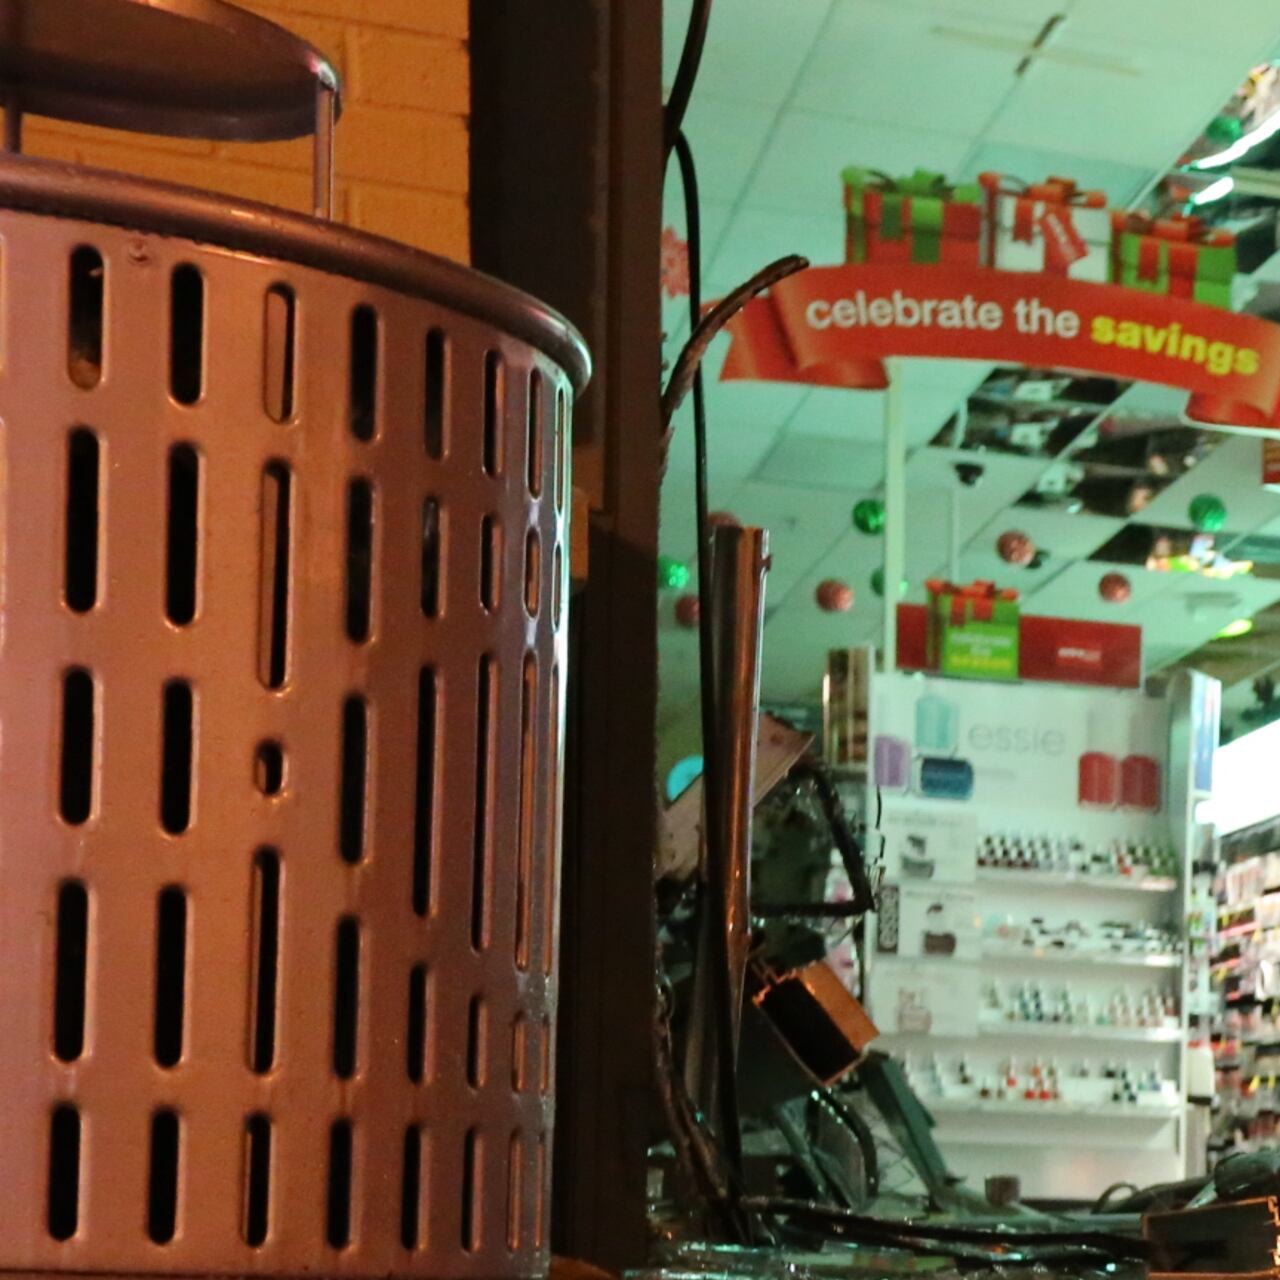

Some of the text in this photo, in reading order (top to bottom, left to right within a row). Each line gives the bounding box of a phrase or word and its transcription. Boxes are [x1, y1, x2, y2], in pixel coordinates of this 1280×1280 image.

[804, 290, 1261, 376] celebrate the savings
[967, 722, 1067, 756] essie
